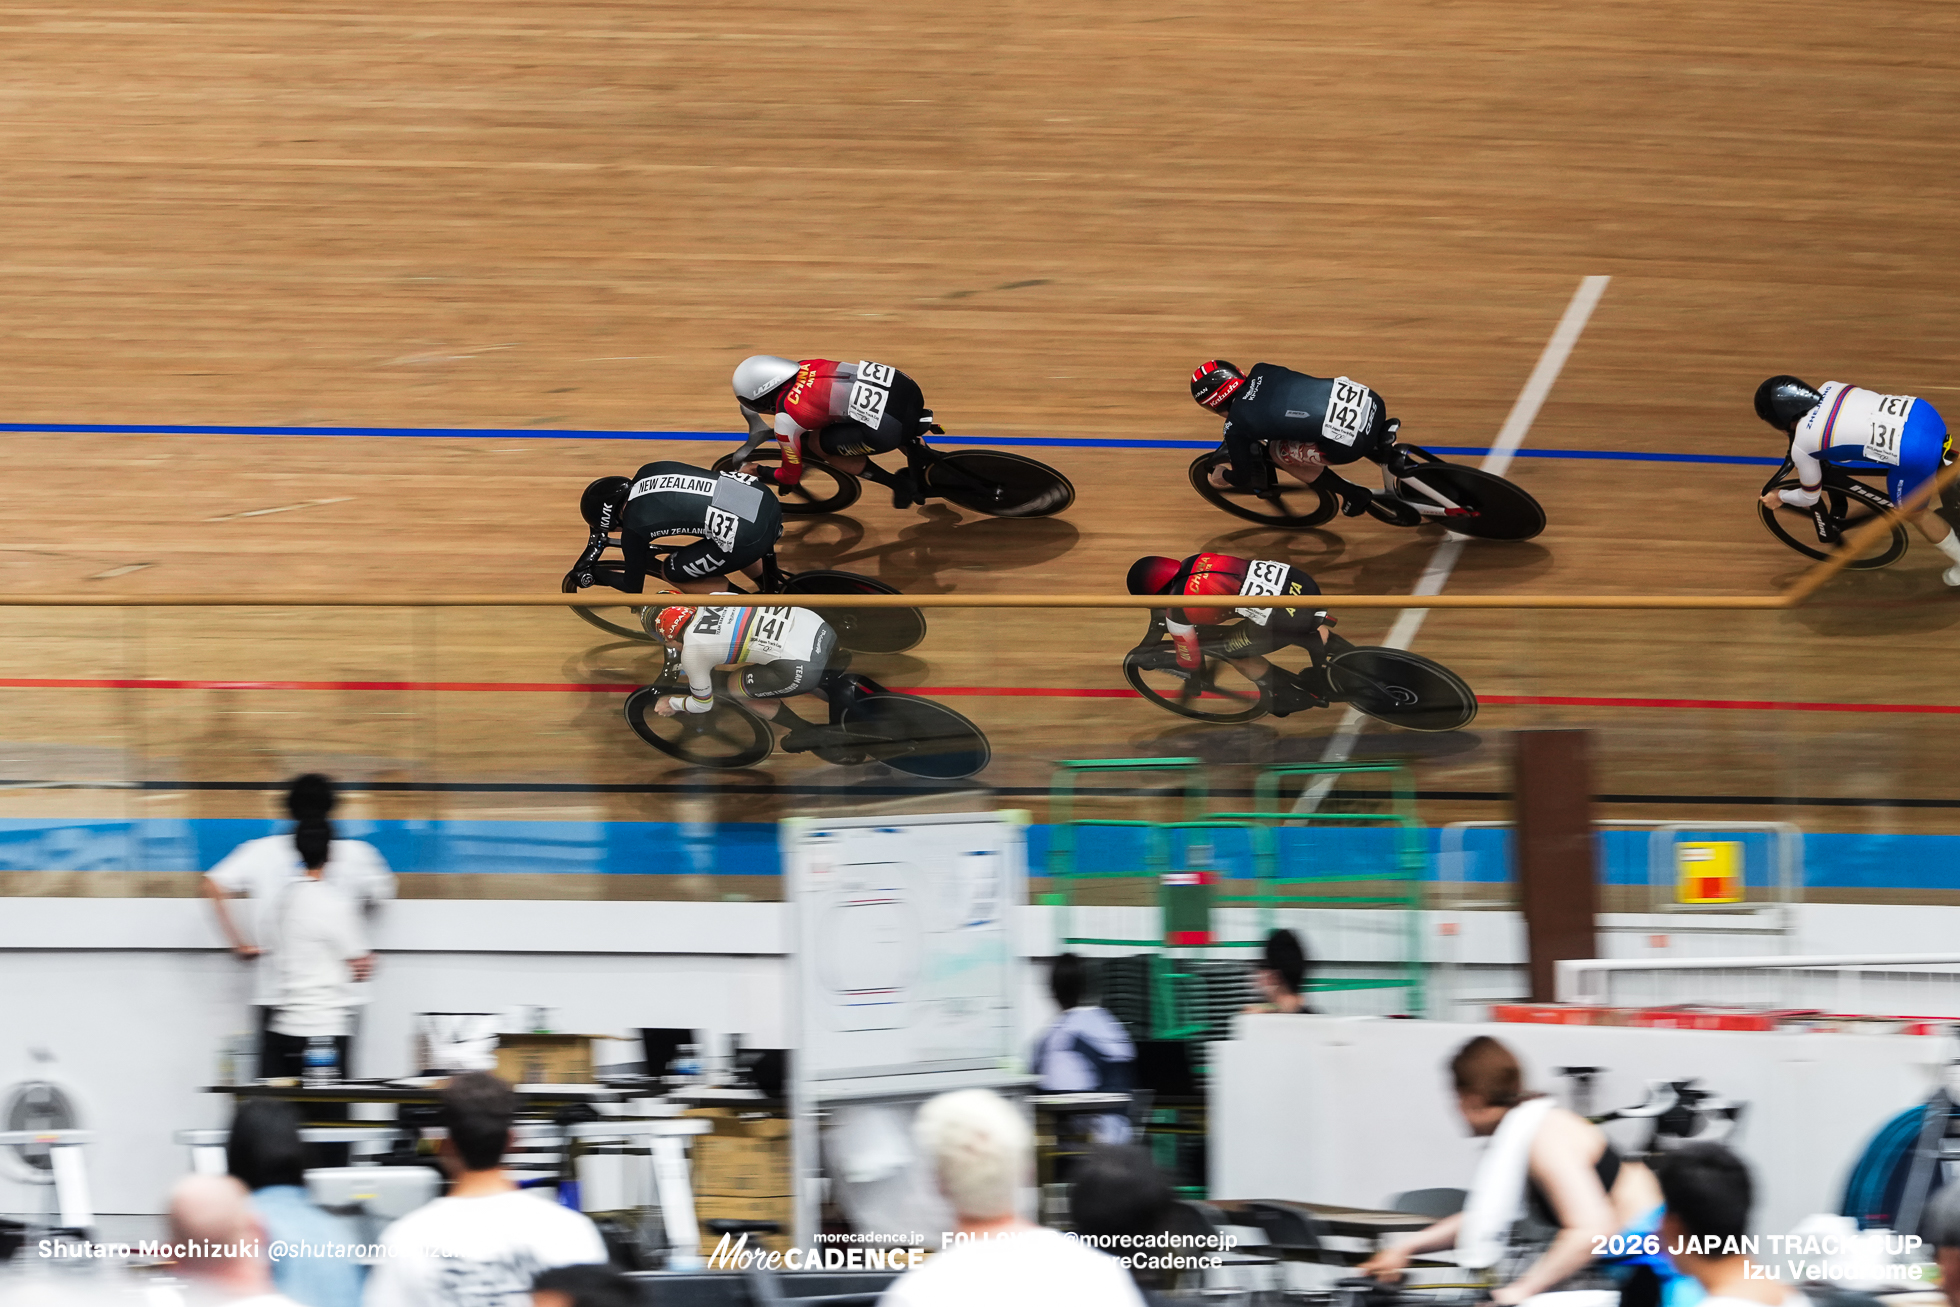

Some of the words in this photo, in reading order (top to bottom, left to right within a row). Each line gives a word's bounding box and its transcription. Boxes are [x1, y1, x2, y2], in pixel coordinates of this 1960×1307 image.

[753, 375, 782, 397] LAZER
[787, 363, 811, 405] CHINA
[806, 370, 817, 388] ANTA
[853, 385, 883, 414] 132
[1210, 381, 1239, 407] Kabuto
[1329, 402, 1358, 431] 142
[1870, 422, 1896, 451] 131
[638, 477, 659, 493] NEW
[659, 476, 712, 493] ZEALAND
[650, 529, 669, 538] NEW
[709, 511, 735, 539] 137
[682, 553, 726, 577] NZL
[1189, 557, 1210, 593] CHINA
[1253, 562, 1283, 586] 133
[1286, 582, 1302, 617] ATA
[669, 608, 689, 634] JAPAN
[755, 615, 784, 641] 141
[794, 665, 803, 684] TEAM
